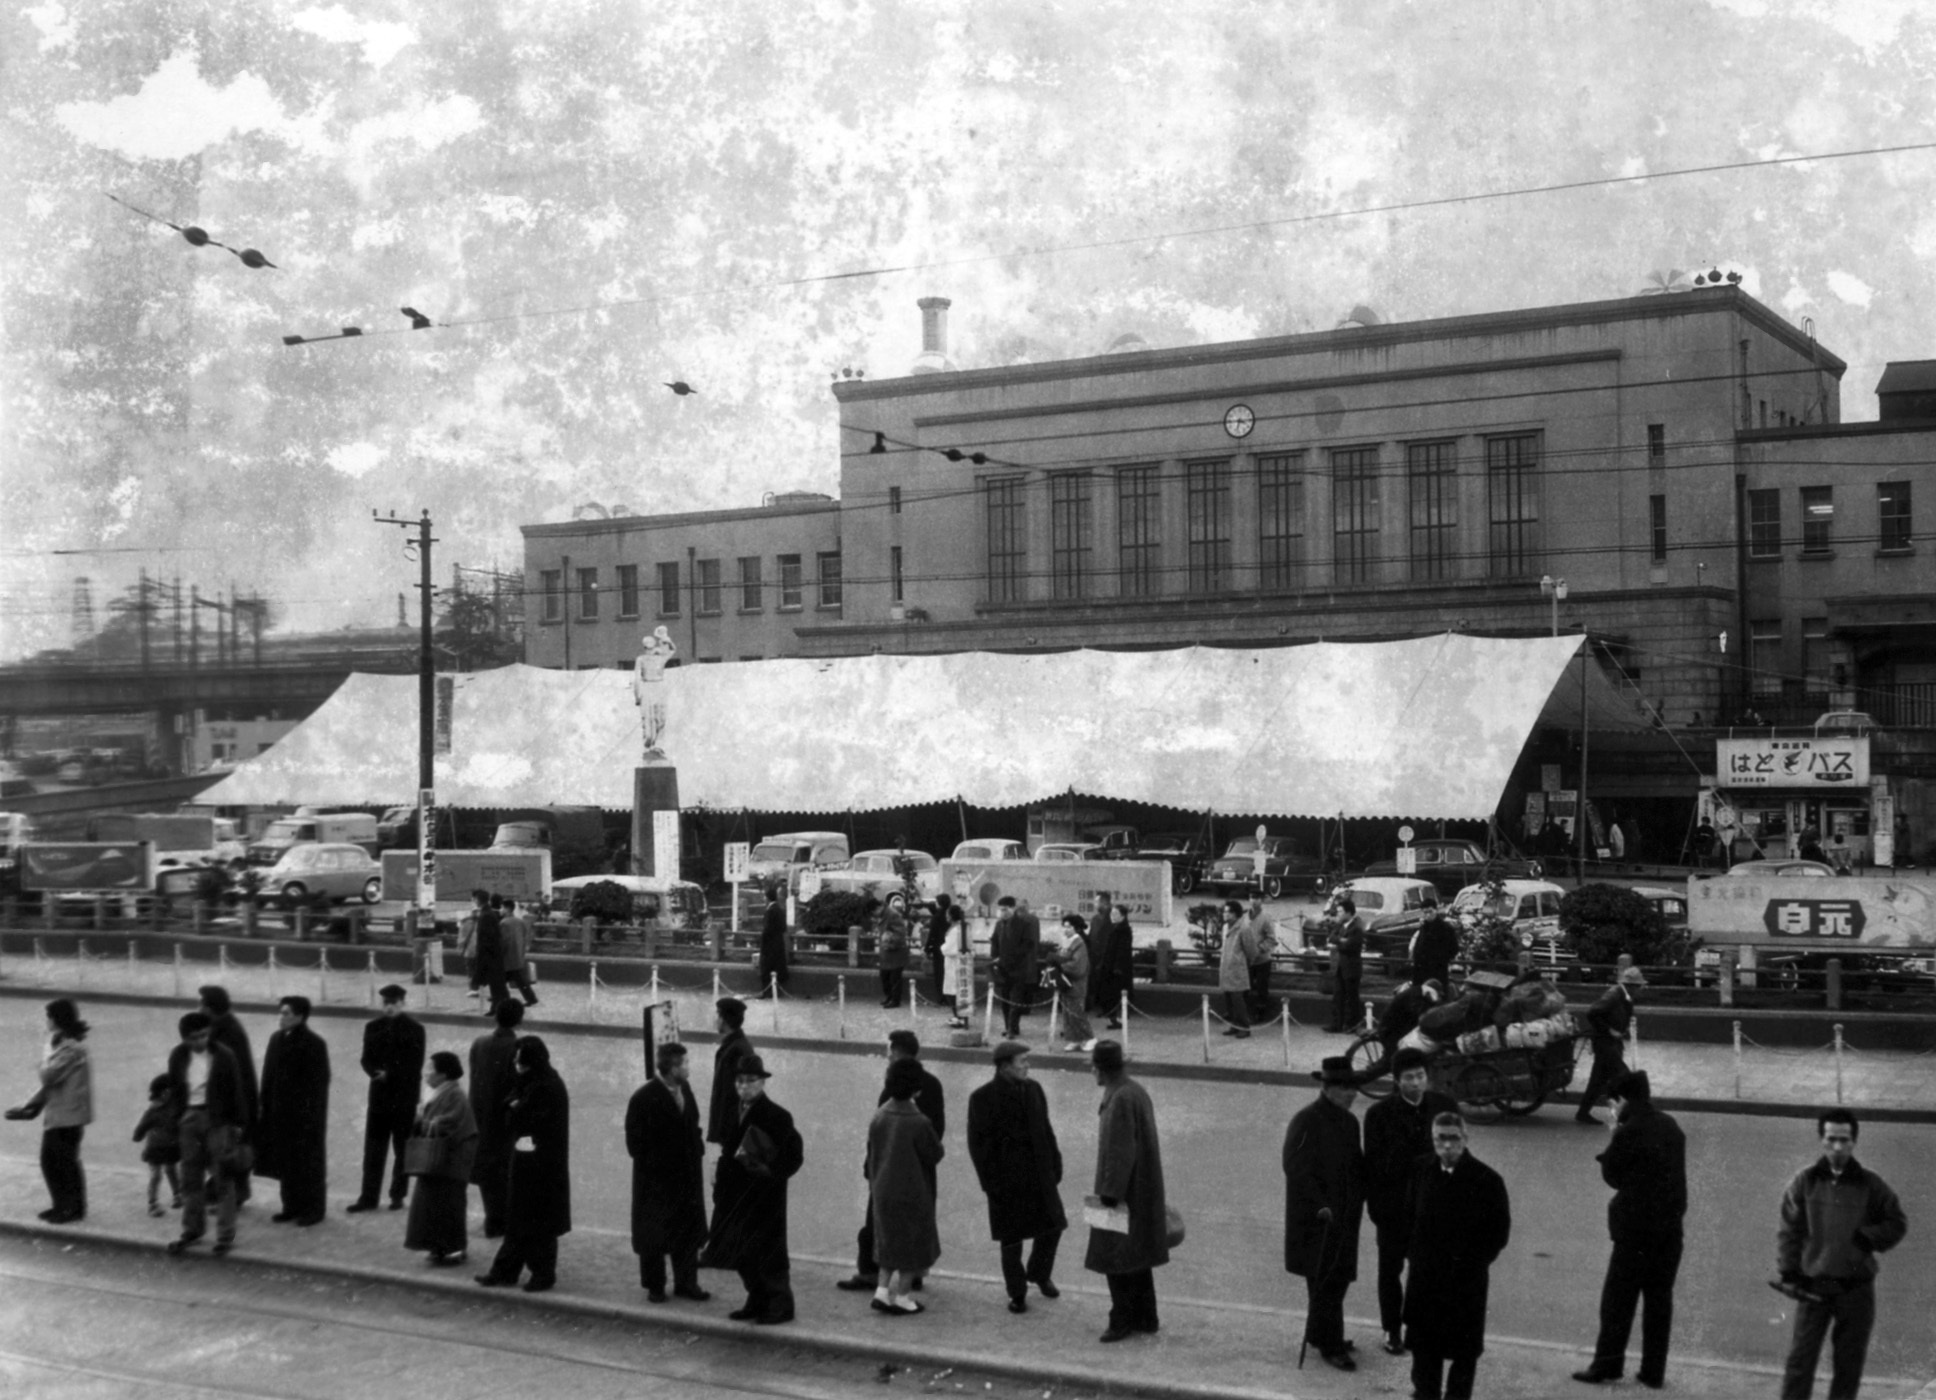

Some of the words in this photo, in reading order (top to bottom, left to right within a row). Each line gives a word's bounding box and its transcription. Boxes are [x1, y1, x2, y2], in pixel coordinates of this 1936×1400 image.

[1731, 753, 1774, 773] はと
[1807, 752, 1853, 773] バス
[1777, 902, 1852, 935] 白元
